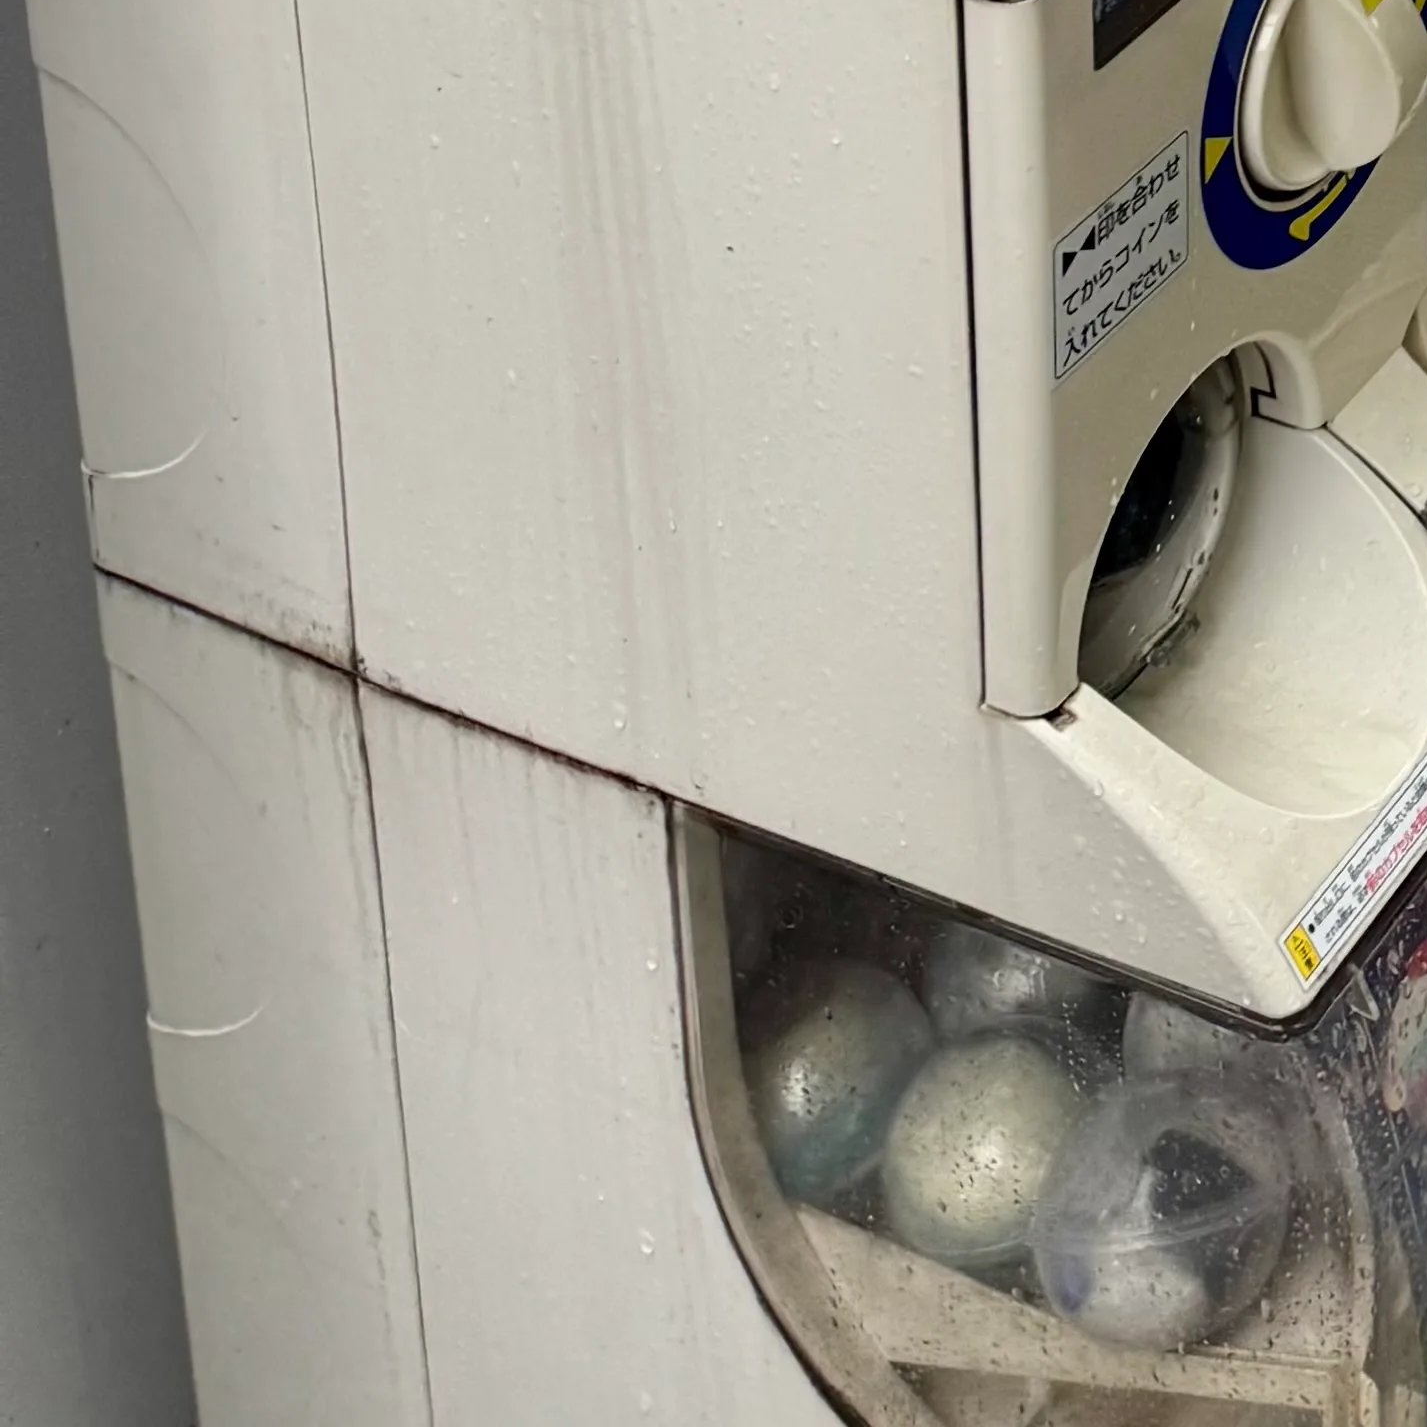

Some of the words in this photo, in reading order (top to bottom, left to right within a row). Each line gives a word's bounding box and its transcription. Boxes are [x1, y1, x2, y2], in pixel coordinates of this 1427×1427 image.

[1098, 154, 1181, 245] 印を合わせ
[1062, 199, 1180, 316] てからコインを
